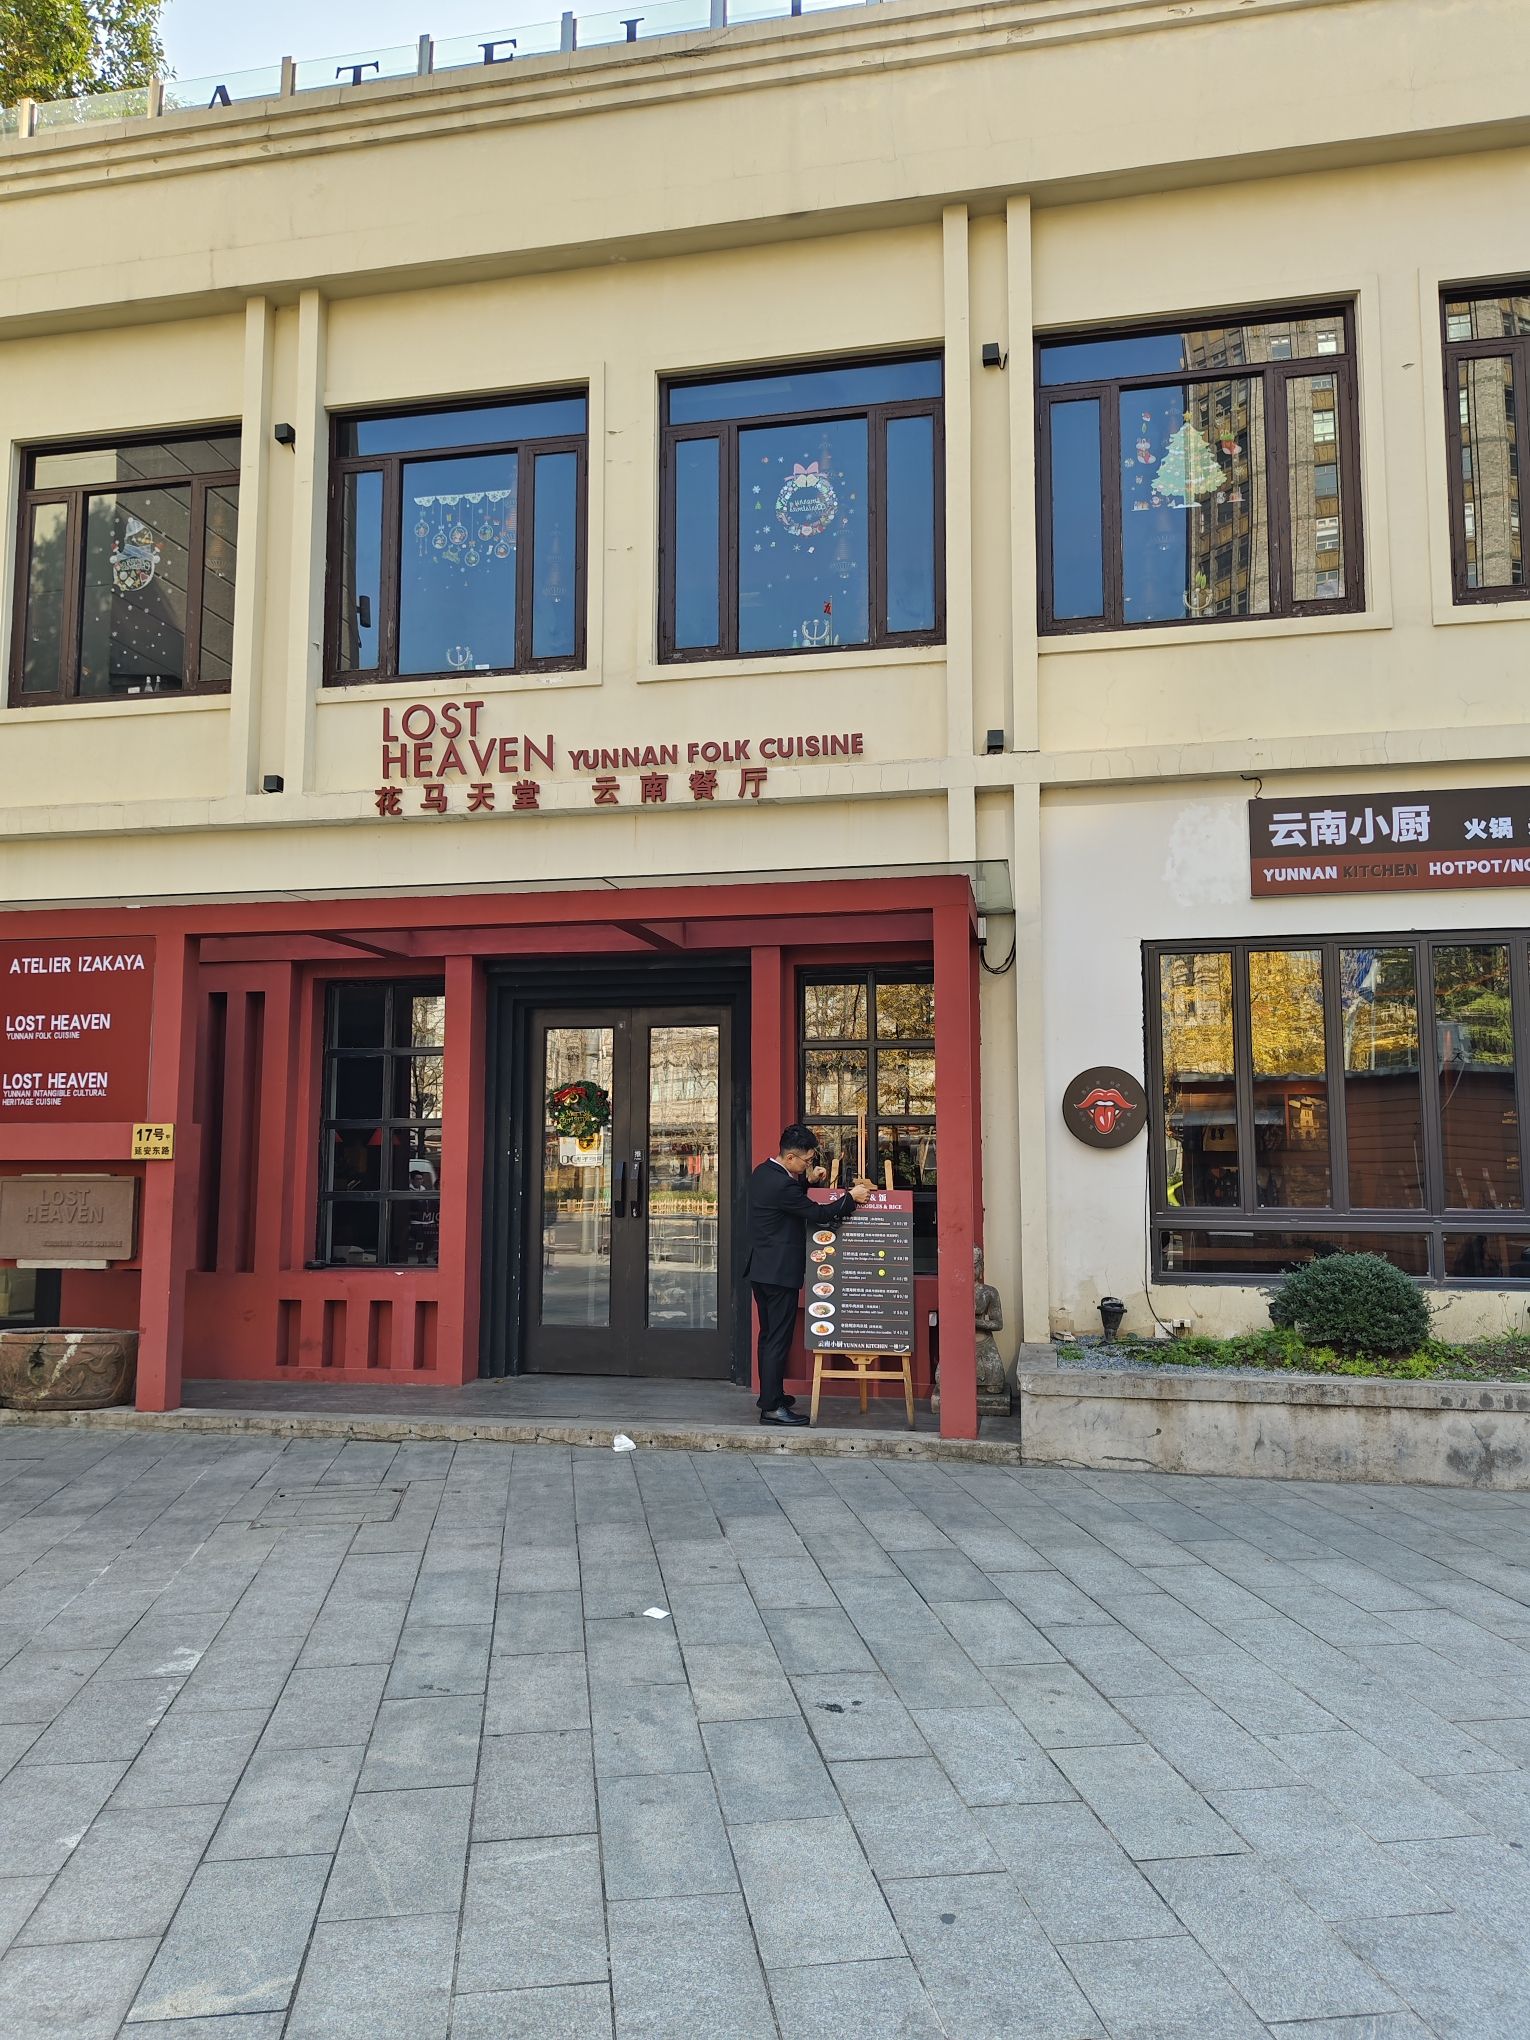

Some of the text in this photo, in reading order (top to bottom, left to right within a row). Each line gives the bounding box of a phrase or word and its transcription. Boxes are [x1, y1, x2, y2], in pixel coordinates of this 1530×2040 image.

[382, 700, 485, 743] LOST
[381, 732, 865, 779] HEAVEN YUNNAN FOLK CUISINE
[375, 767, 768, 816] 花马天堂 云南餐厅
[1268, 805, 1513, 848] 云南小厨 火锅
[1263, 865, 1338, 882] YUNNAN
[1342, 862, 1419, 879] KITCHEN
[9, 954, 145, 974] ATELIER IZAKAYA
[6, 1013, 111, 1032] LOST HEAVEN
[53, 1031, 80, 1039] CUISINE
[3, 1072, 108, 1089] LOST HEAVEN
[2, 1098, 34, 1106] HERITAGE
[134, 1146, 170, 1155] 延安东路
[40, 1189, 91, 1207] LOST
[25, 1206, 104, 1224] HEAVEN
